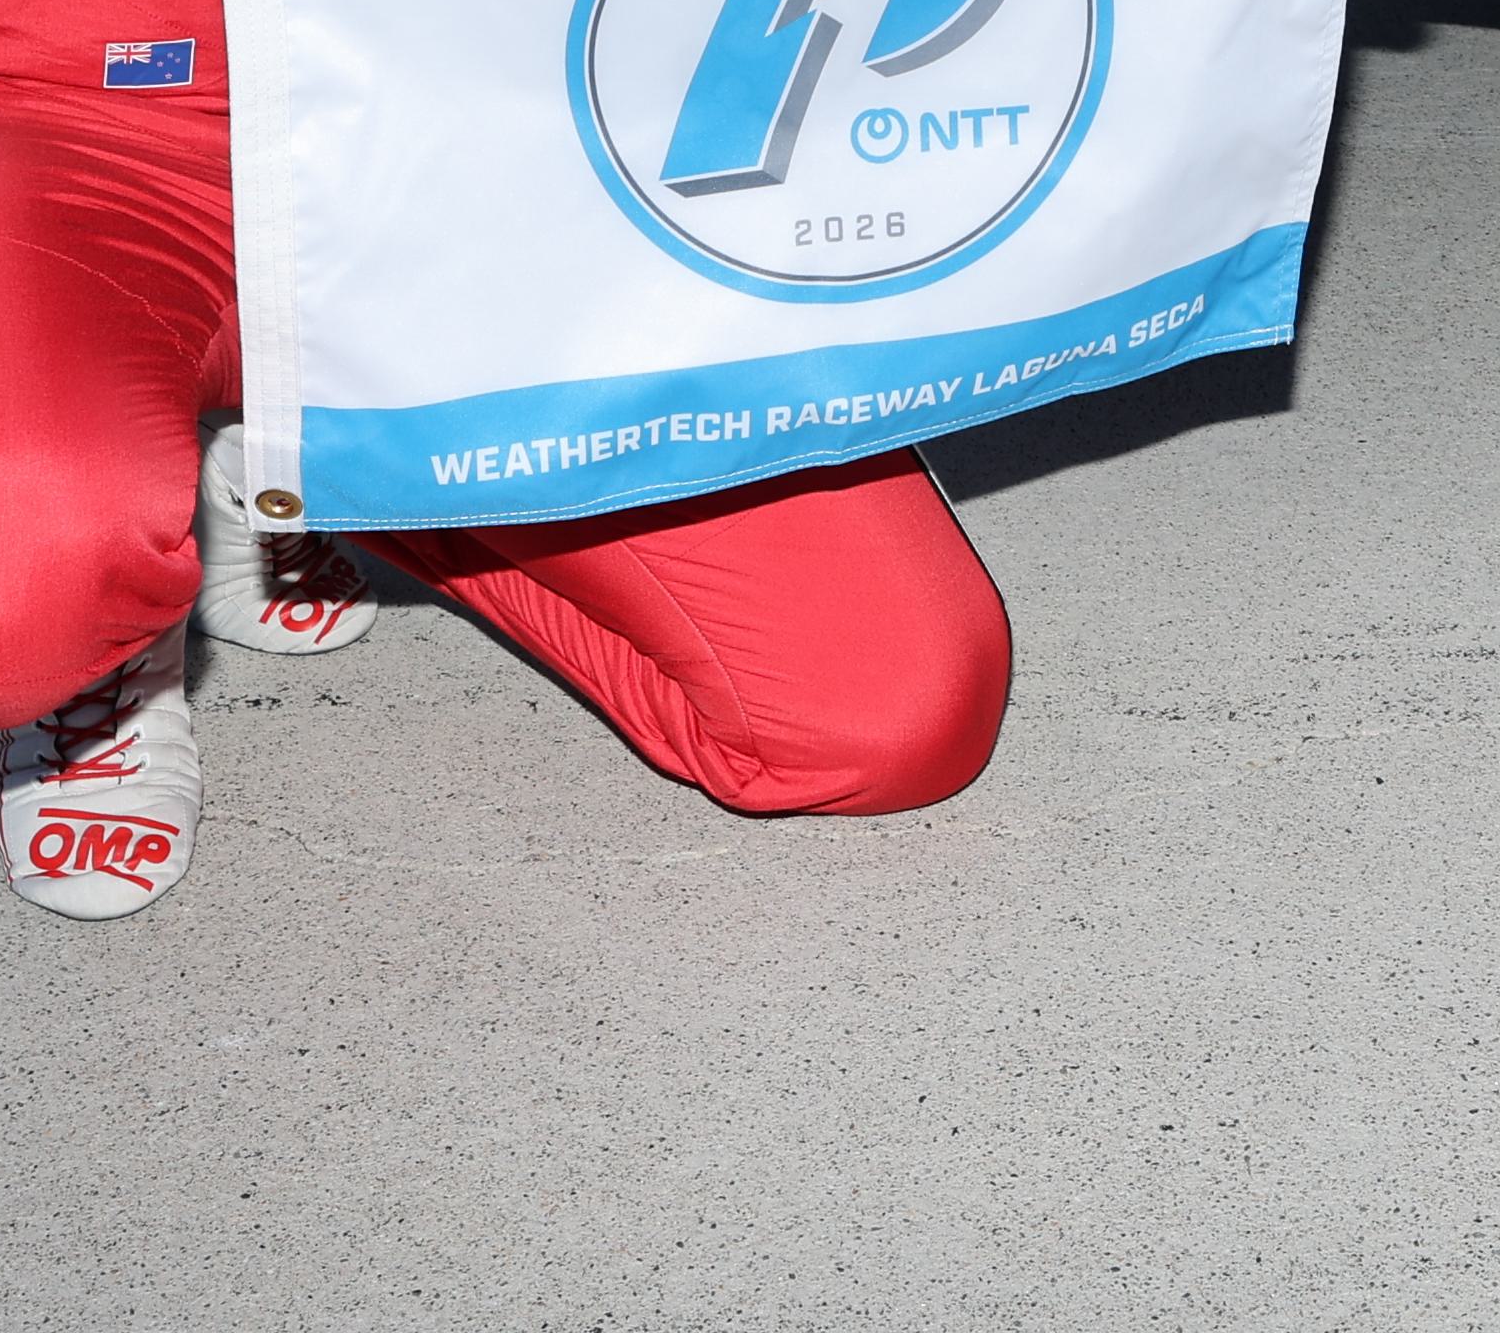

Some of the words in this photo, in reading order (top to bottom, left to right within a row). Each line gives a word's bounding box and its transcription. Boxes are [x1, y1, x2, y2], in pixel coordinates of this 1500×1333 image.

[920, 104, 1031, 153] NTT
[793, 209, 908, 248] 2026
[430, 406, 751, 488] WEATHERTECH
[765, 375, 962, 436] RACEWAY
[971, 332, 1118, 398] LAGUNA
[1128, 292, 1207, 351] SECA
[29, 822, 172, 874] OMP
